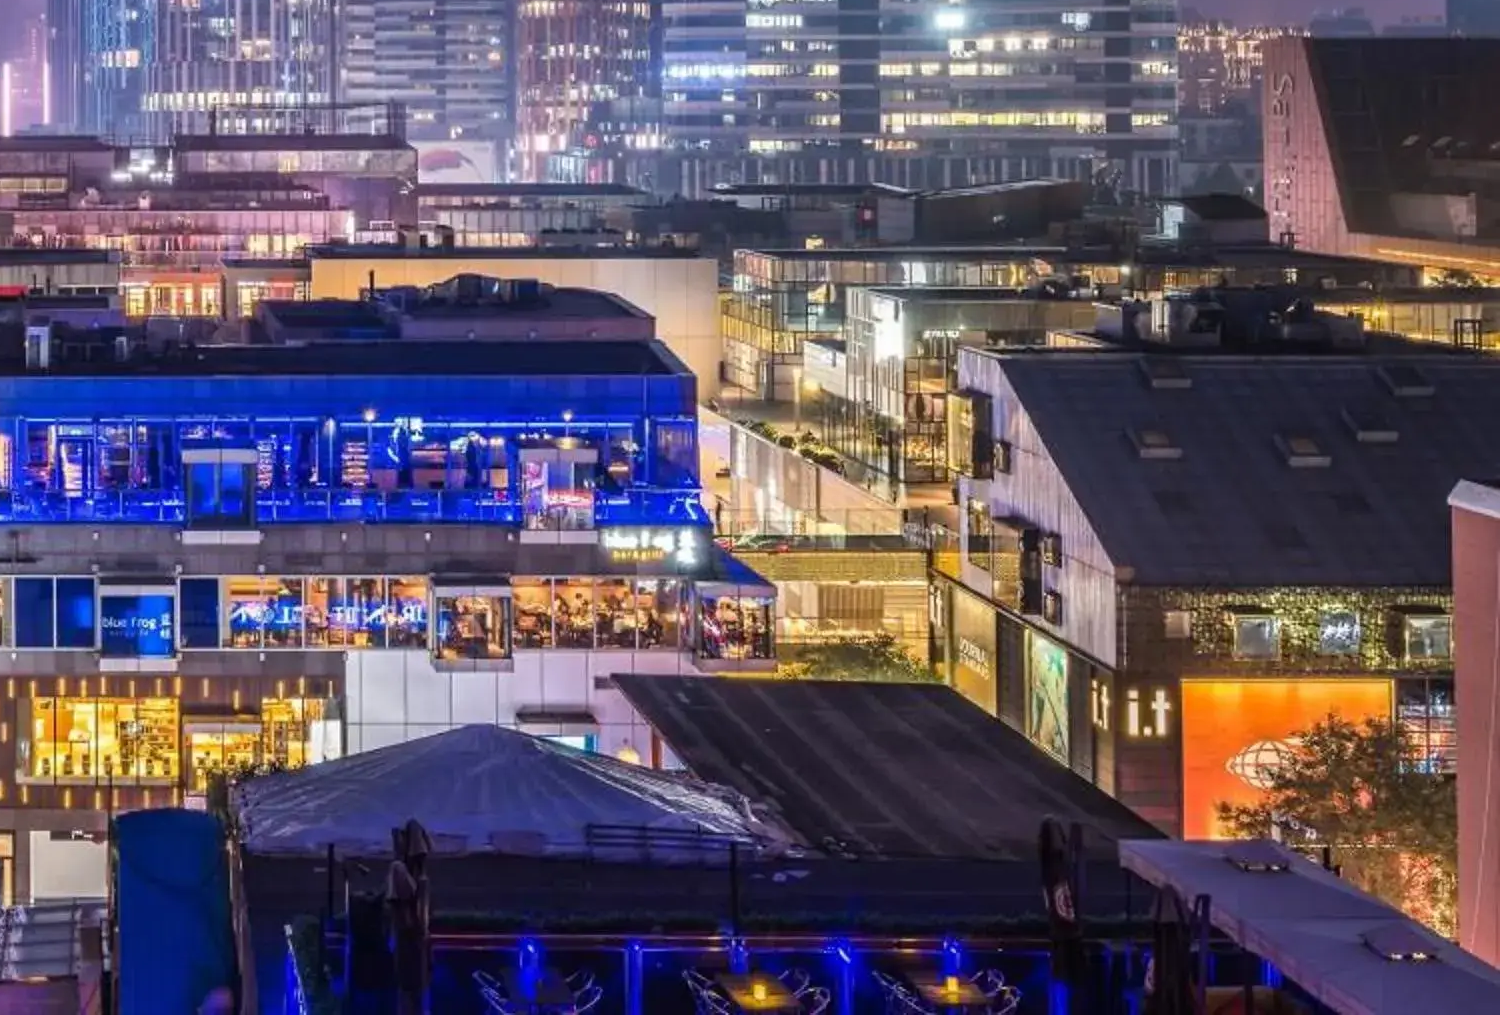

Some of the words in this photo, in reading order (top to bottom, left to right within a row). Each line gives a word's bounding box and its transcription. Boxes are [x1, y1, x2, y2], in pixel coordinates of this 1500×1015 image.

[101, 616, 128, 628] blue
[131, 616, 158, 630] frog
[1126, 688, 1172, 738] i.t
